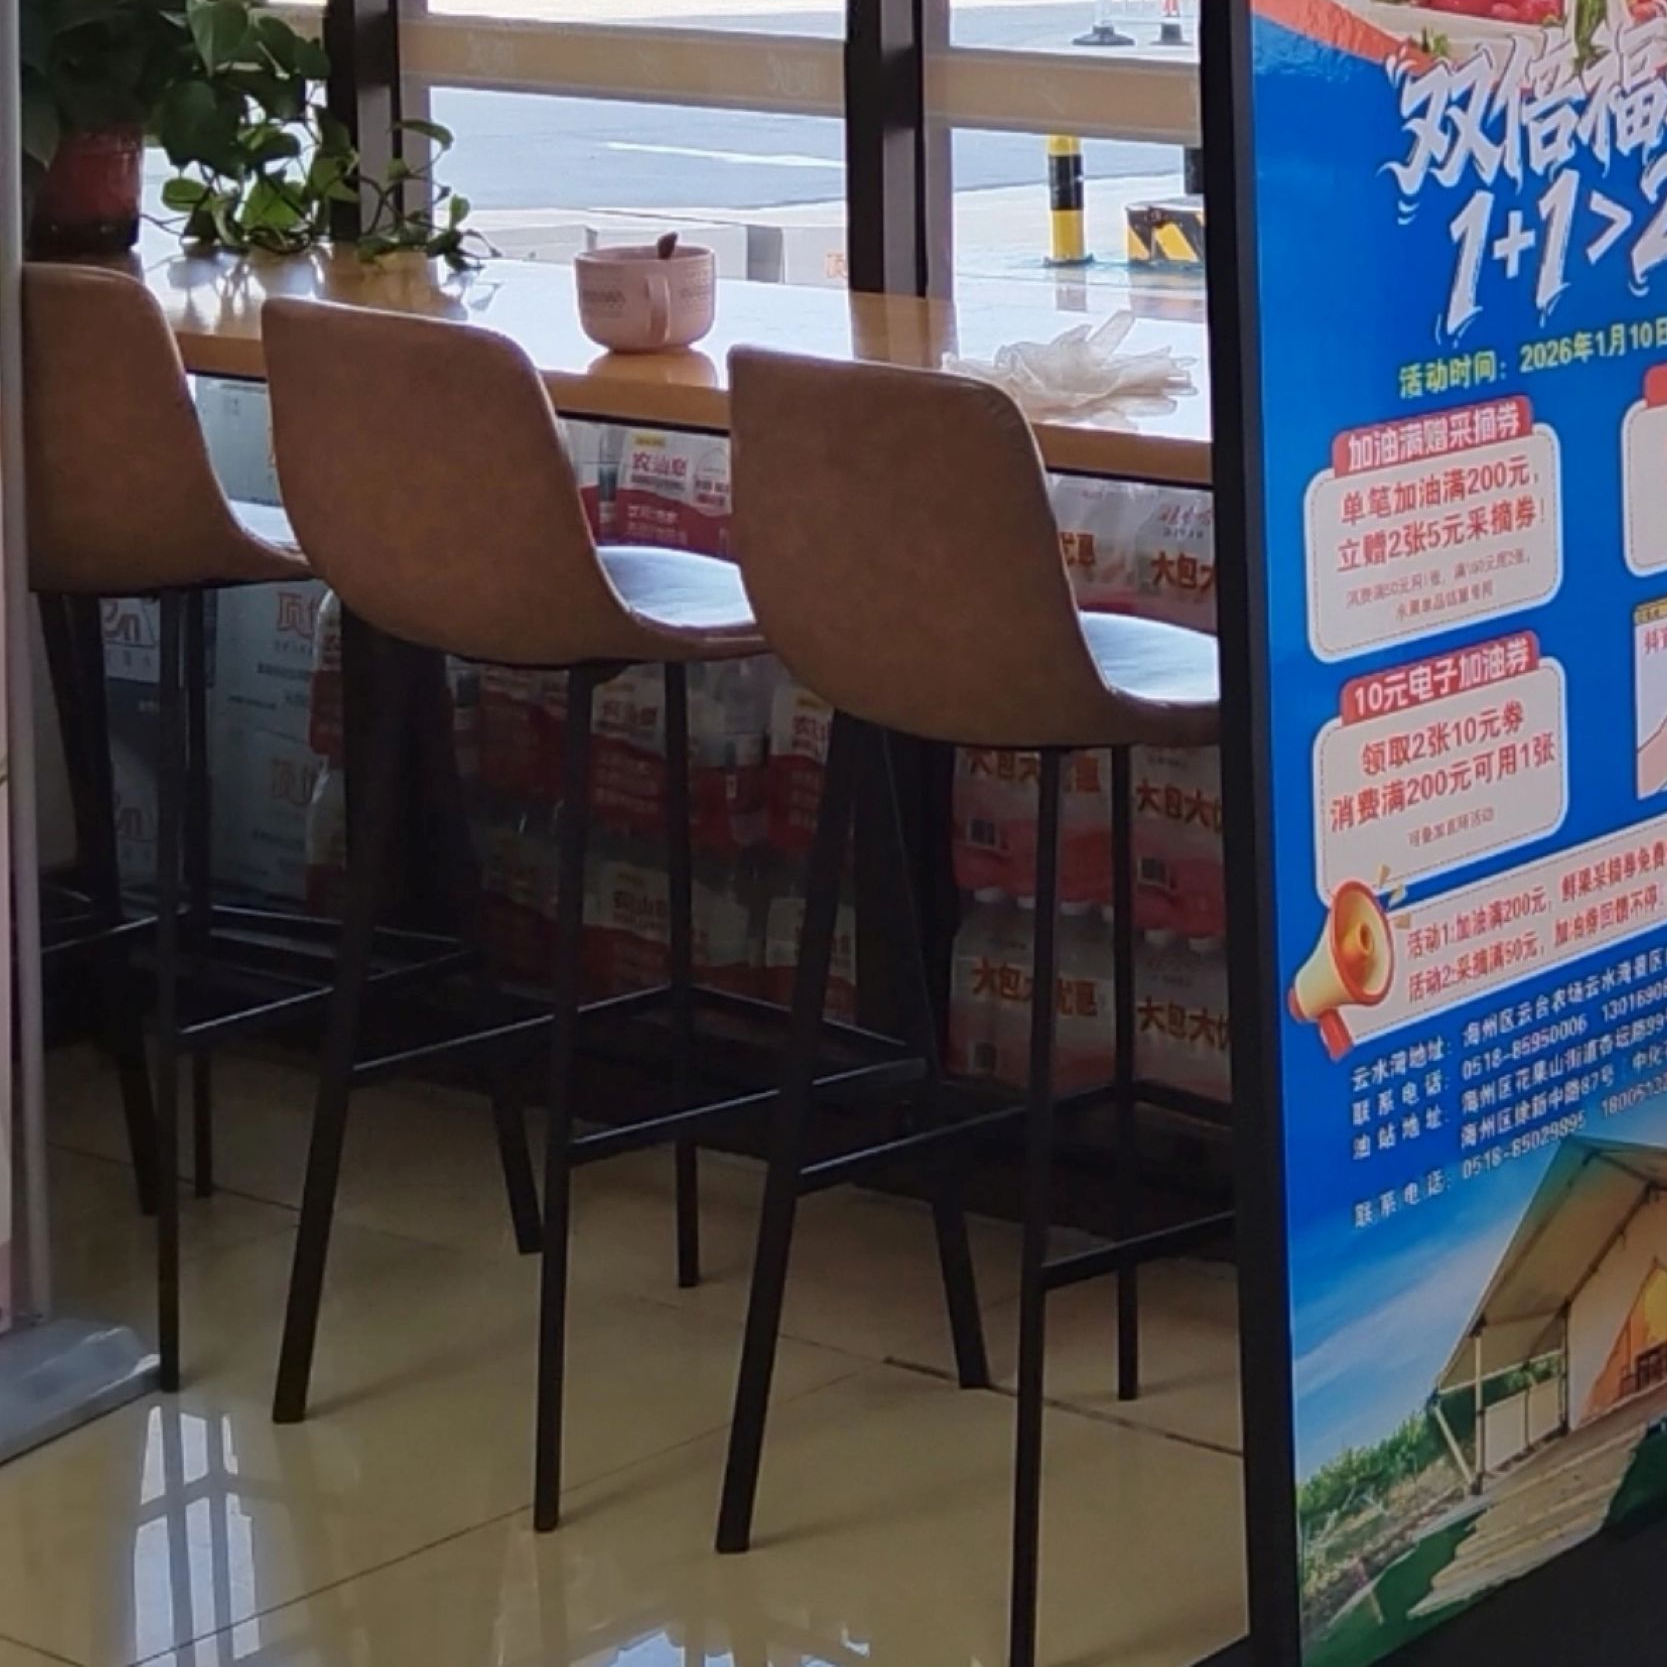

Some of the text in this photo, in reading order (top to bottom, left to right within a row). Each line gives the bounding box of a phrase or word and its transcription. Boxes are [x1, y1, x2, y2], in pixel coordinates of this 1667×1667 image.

[1347, 401, 1520, 472] 加油满赠采摘券
[1354, 637, 1530, 716] 10元电子加油券
[1361, 700, 1524, 776] 领取2张10元券
[1330, 731, 1556, 832] 消费满200元可用1张
